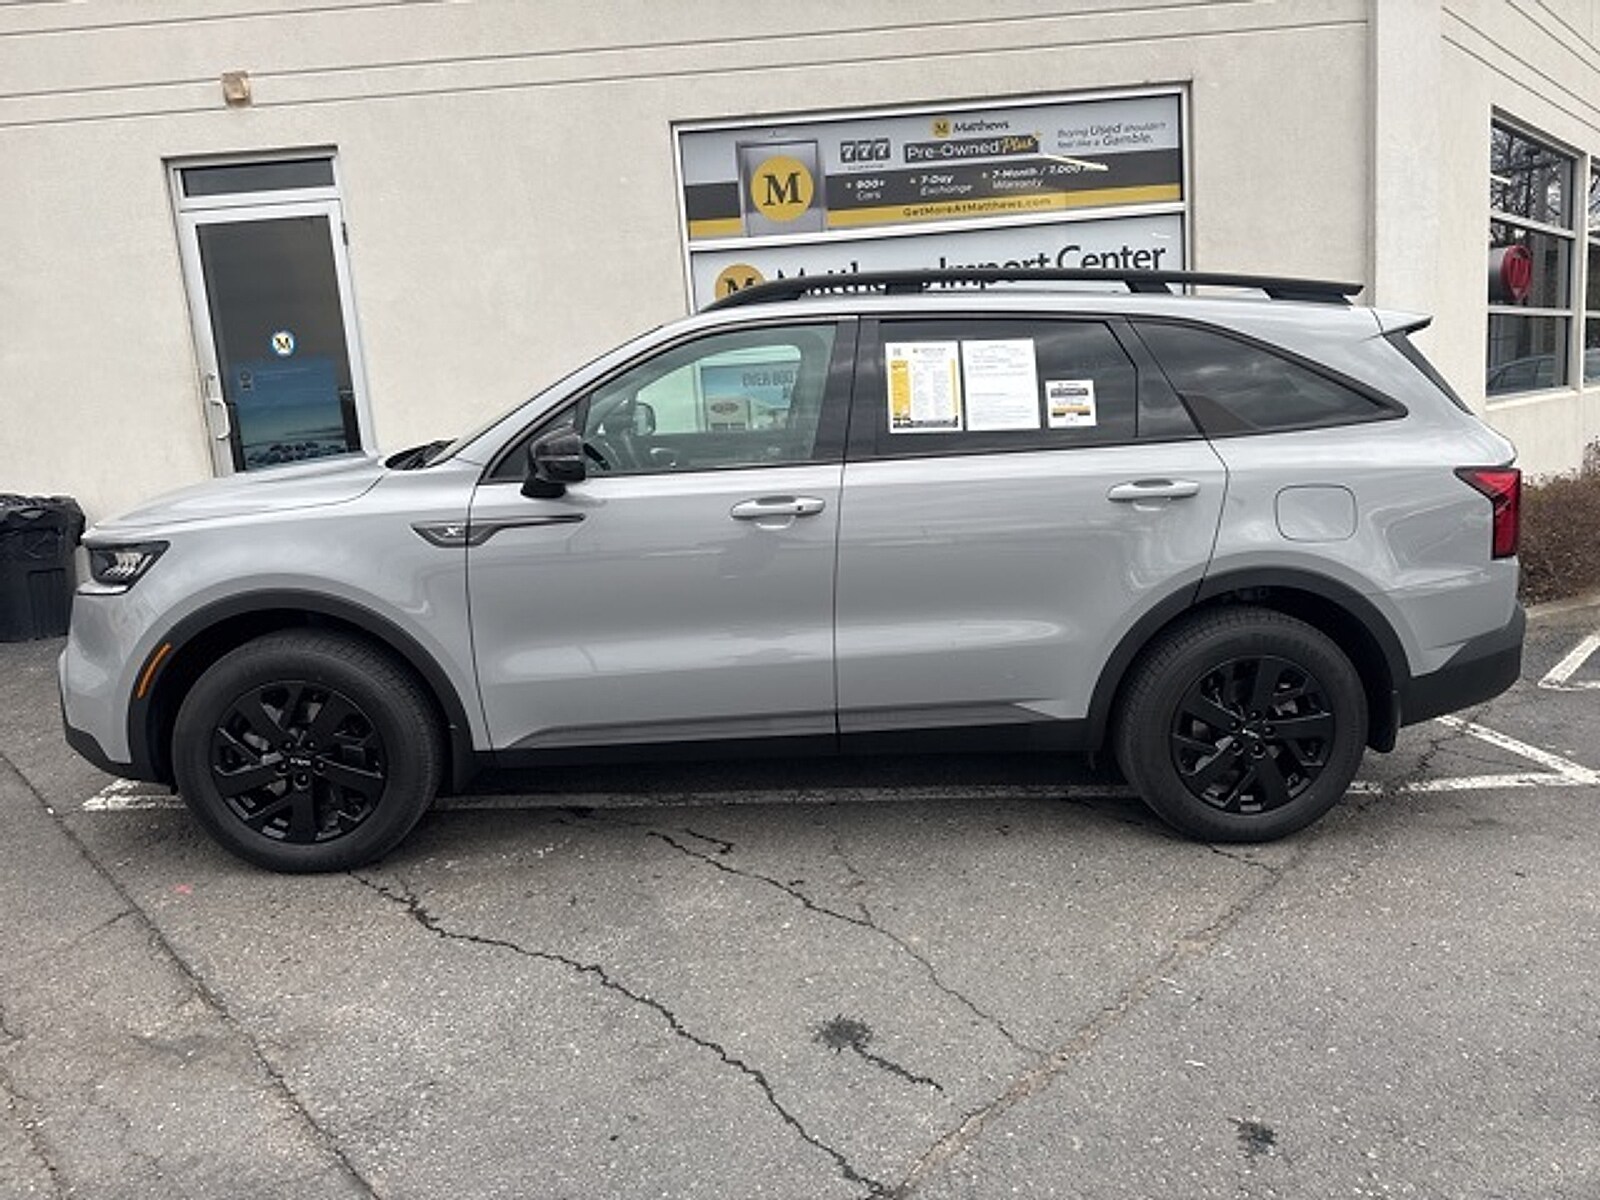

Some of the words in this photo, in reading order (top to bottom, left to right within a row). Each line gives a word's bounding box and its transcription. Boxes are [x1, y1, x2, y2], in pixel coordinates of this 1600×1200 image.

[953, 120, 1010, 132] Matthews
[1090, 124, 1120, 136] Used
[842, 142, 888, 160] 777
[906, 140, 999, 159] Pre-Owned
[992, 167, 1037, 179] 7-Month
[920, 174, 954, 186] 7-Day
[992, 178, 1044, 189] Warranty
[763, 171, 804, 206] M
[920, 183, 973, 197] Exchange
[856, 190, 881, 201] Cars
[902, 198, 1052, 217] GetMoreAtMatthews.com
[1056, 245, 1166, 271] Center
